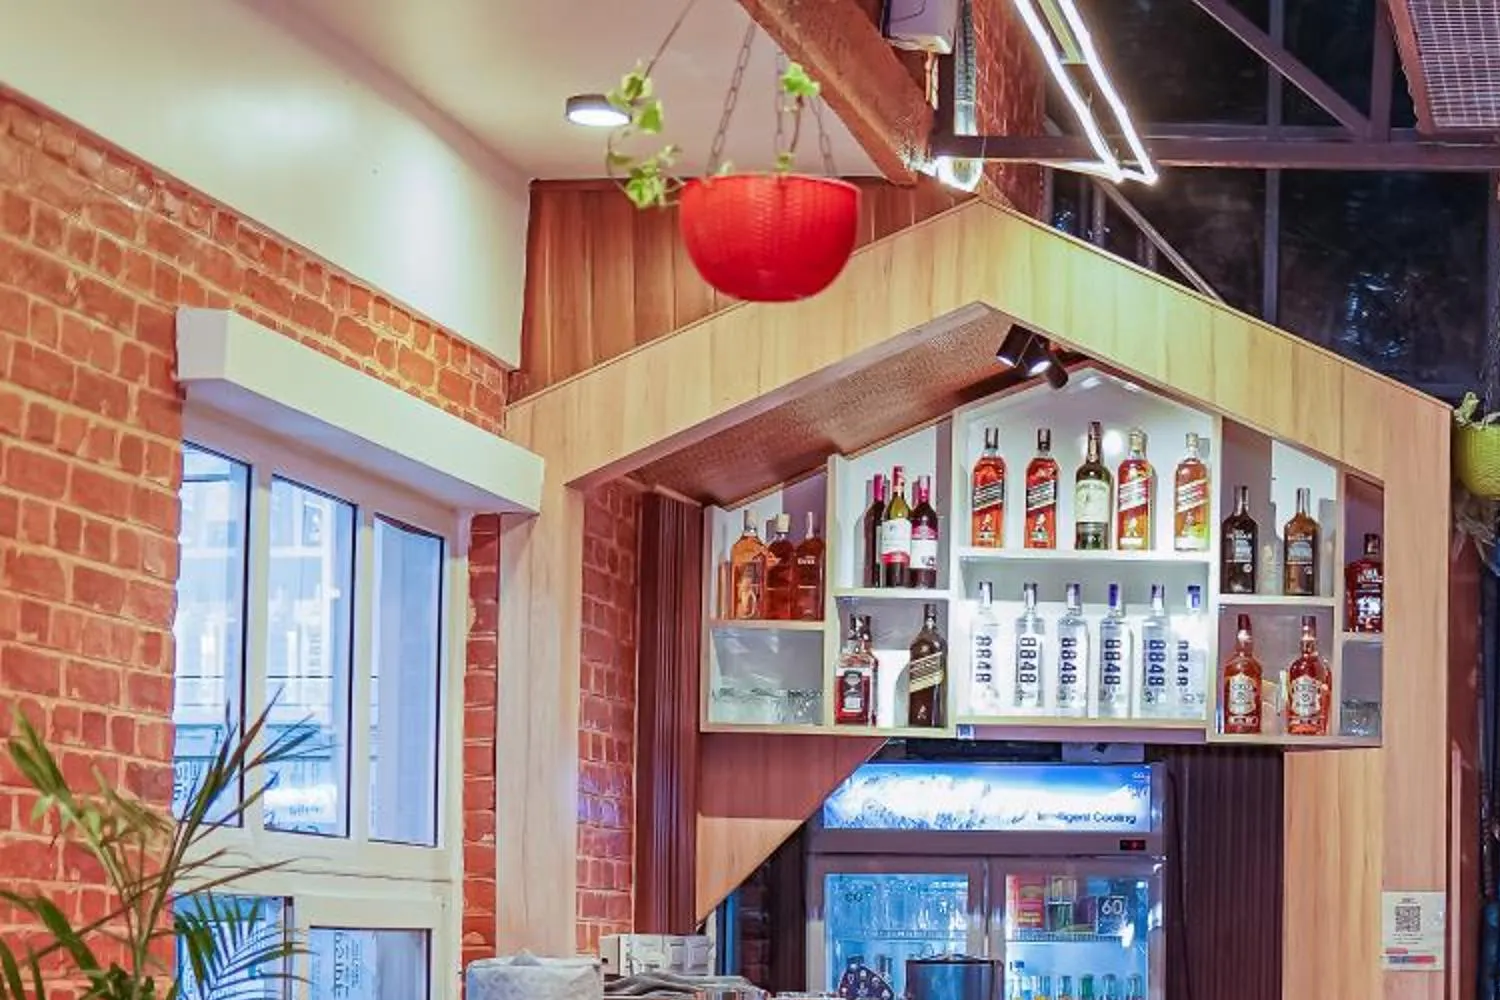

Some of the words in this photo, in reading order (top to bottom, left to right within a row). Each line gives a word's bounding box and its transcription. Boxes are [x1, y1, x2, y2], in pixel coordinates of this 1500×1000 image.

[1019, 637, 1037, 684] 8848
[1061, 637, 1077, 685] 8848
[1103, 639, 1121, 686] 8848
[1148, 639, 1166, 687] 8848
[1037, 812, 1091, 823] Iligent
[1093, 811, 1136, 825] Cooling
[1101, 899, 1123, 915] 60
